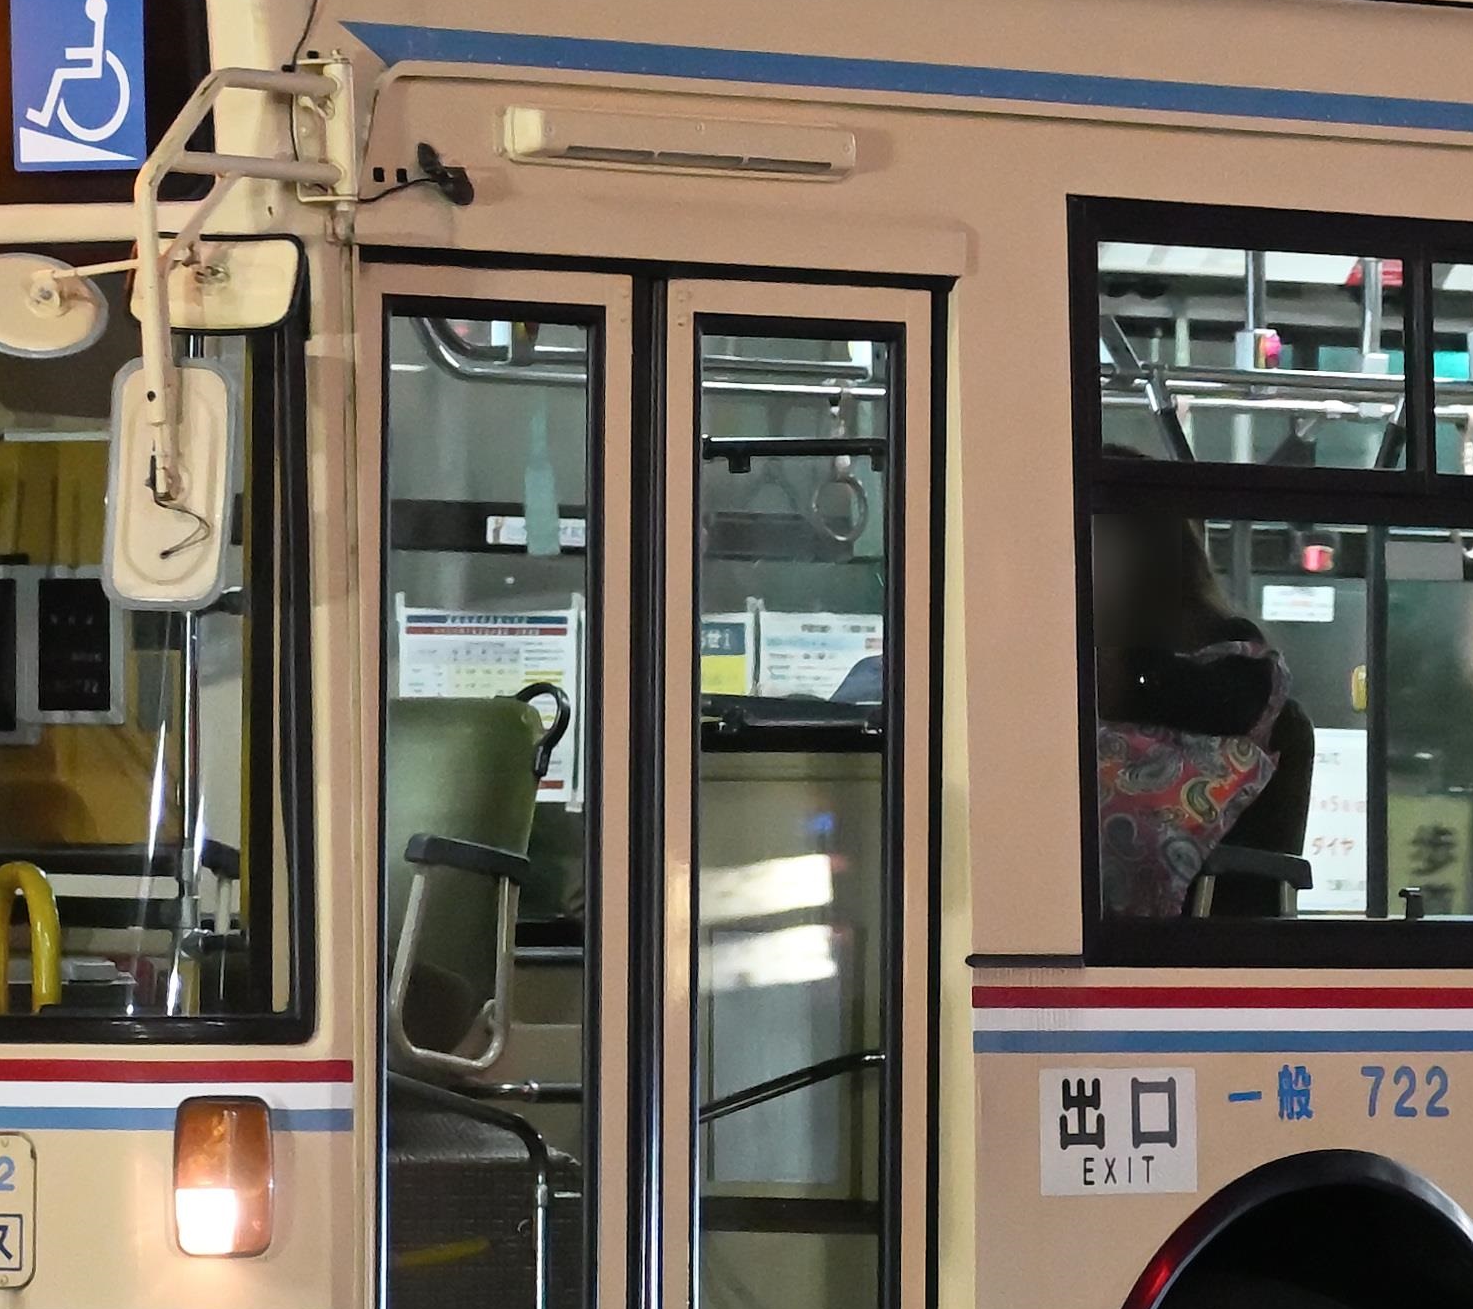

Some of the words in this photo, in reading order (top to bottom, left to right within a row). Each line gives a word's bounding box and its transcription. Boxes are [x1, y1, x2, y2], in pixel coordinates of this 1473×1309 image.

[1059, 1077, 1179, 1150] 出口
[1228, 1066, 1314, 1121] 一般
[1361, 1066, 1451, 1118] 722
[1082, 1157, 1156, 1187] EXIT
